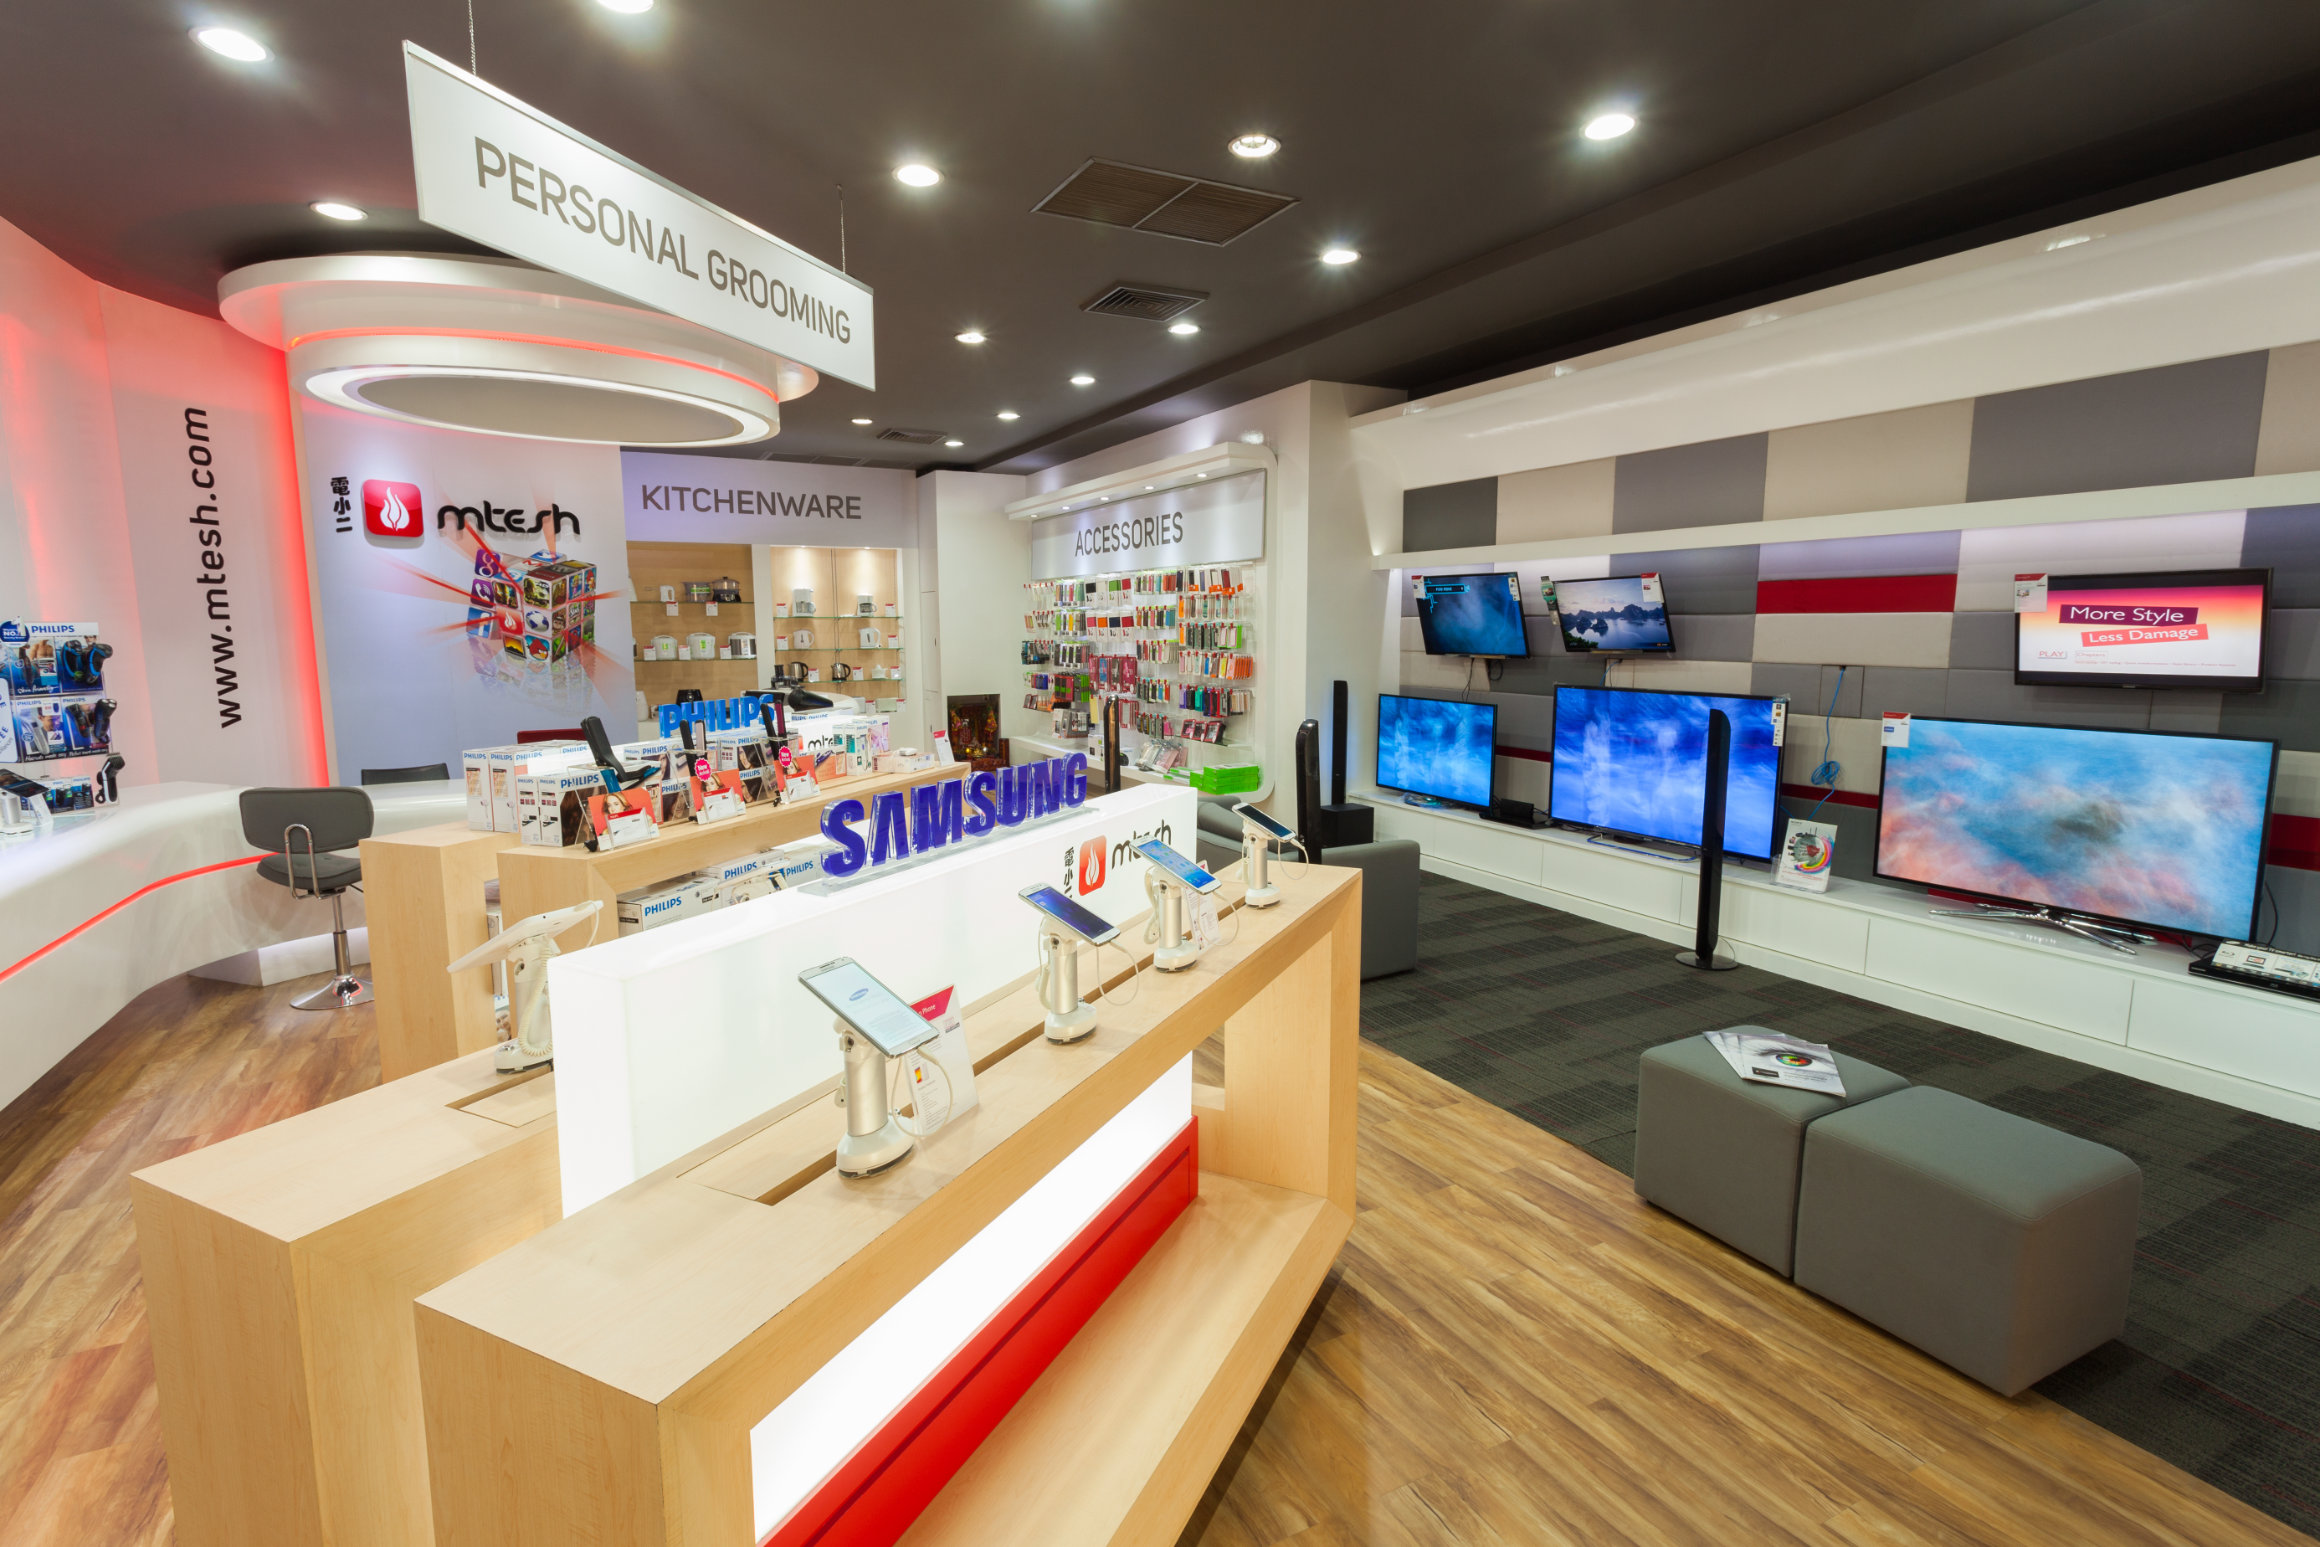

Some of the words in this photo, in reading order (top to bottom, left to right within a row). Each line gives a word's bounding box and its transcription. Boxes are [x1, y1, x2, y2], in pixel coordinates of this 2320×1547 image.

[474, 136, 699, 281] PERSONAL
[708, 249, 851, 344] GROOMING
[331, 476, 353, 532] 電小二
[642, 485, 862, 519] KITCHENWARE
[437, 501, 581, 535] mtesh
[1075, 512, 1183, 557] ACCESSORIES
[184, 407, 242, 728] www.mtesh.com
[2070, 606, 2126, 621] More
[2132, 607, 2184, 625] Style
[31, 625, 75, 633] PHILIPS
[2089, 632, 2123, 643] Less
[2129, 627, 2199, 641] Damage
[658, 694, 775, 738] PHILIPS
[464, 752, 487, 760] PHILIPS
[490, 753, 513, 761] PHILIPS
[516, 752, 543, 760] PHILIPS
[562, 746, 588, 754] PHILIPS
[642, 746, 668, 755] PHILIPS
[560, 774, 600, 789] PHILIPS
[740, 769, 760, 779] PHILIPS
[820, 752, 1088, 878] SAMSUNG
[724, 861, 758, 880] PHILIPS
[786, 860, 814, 877] PHILIPS
[644, 896, 682, 917] PHILIPS
